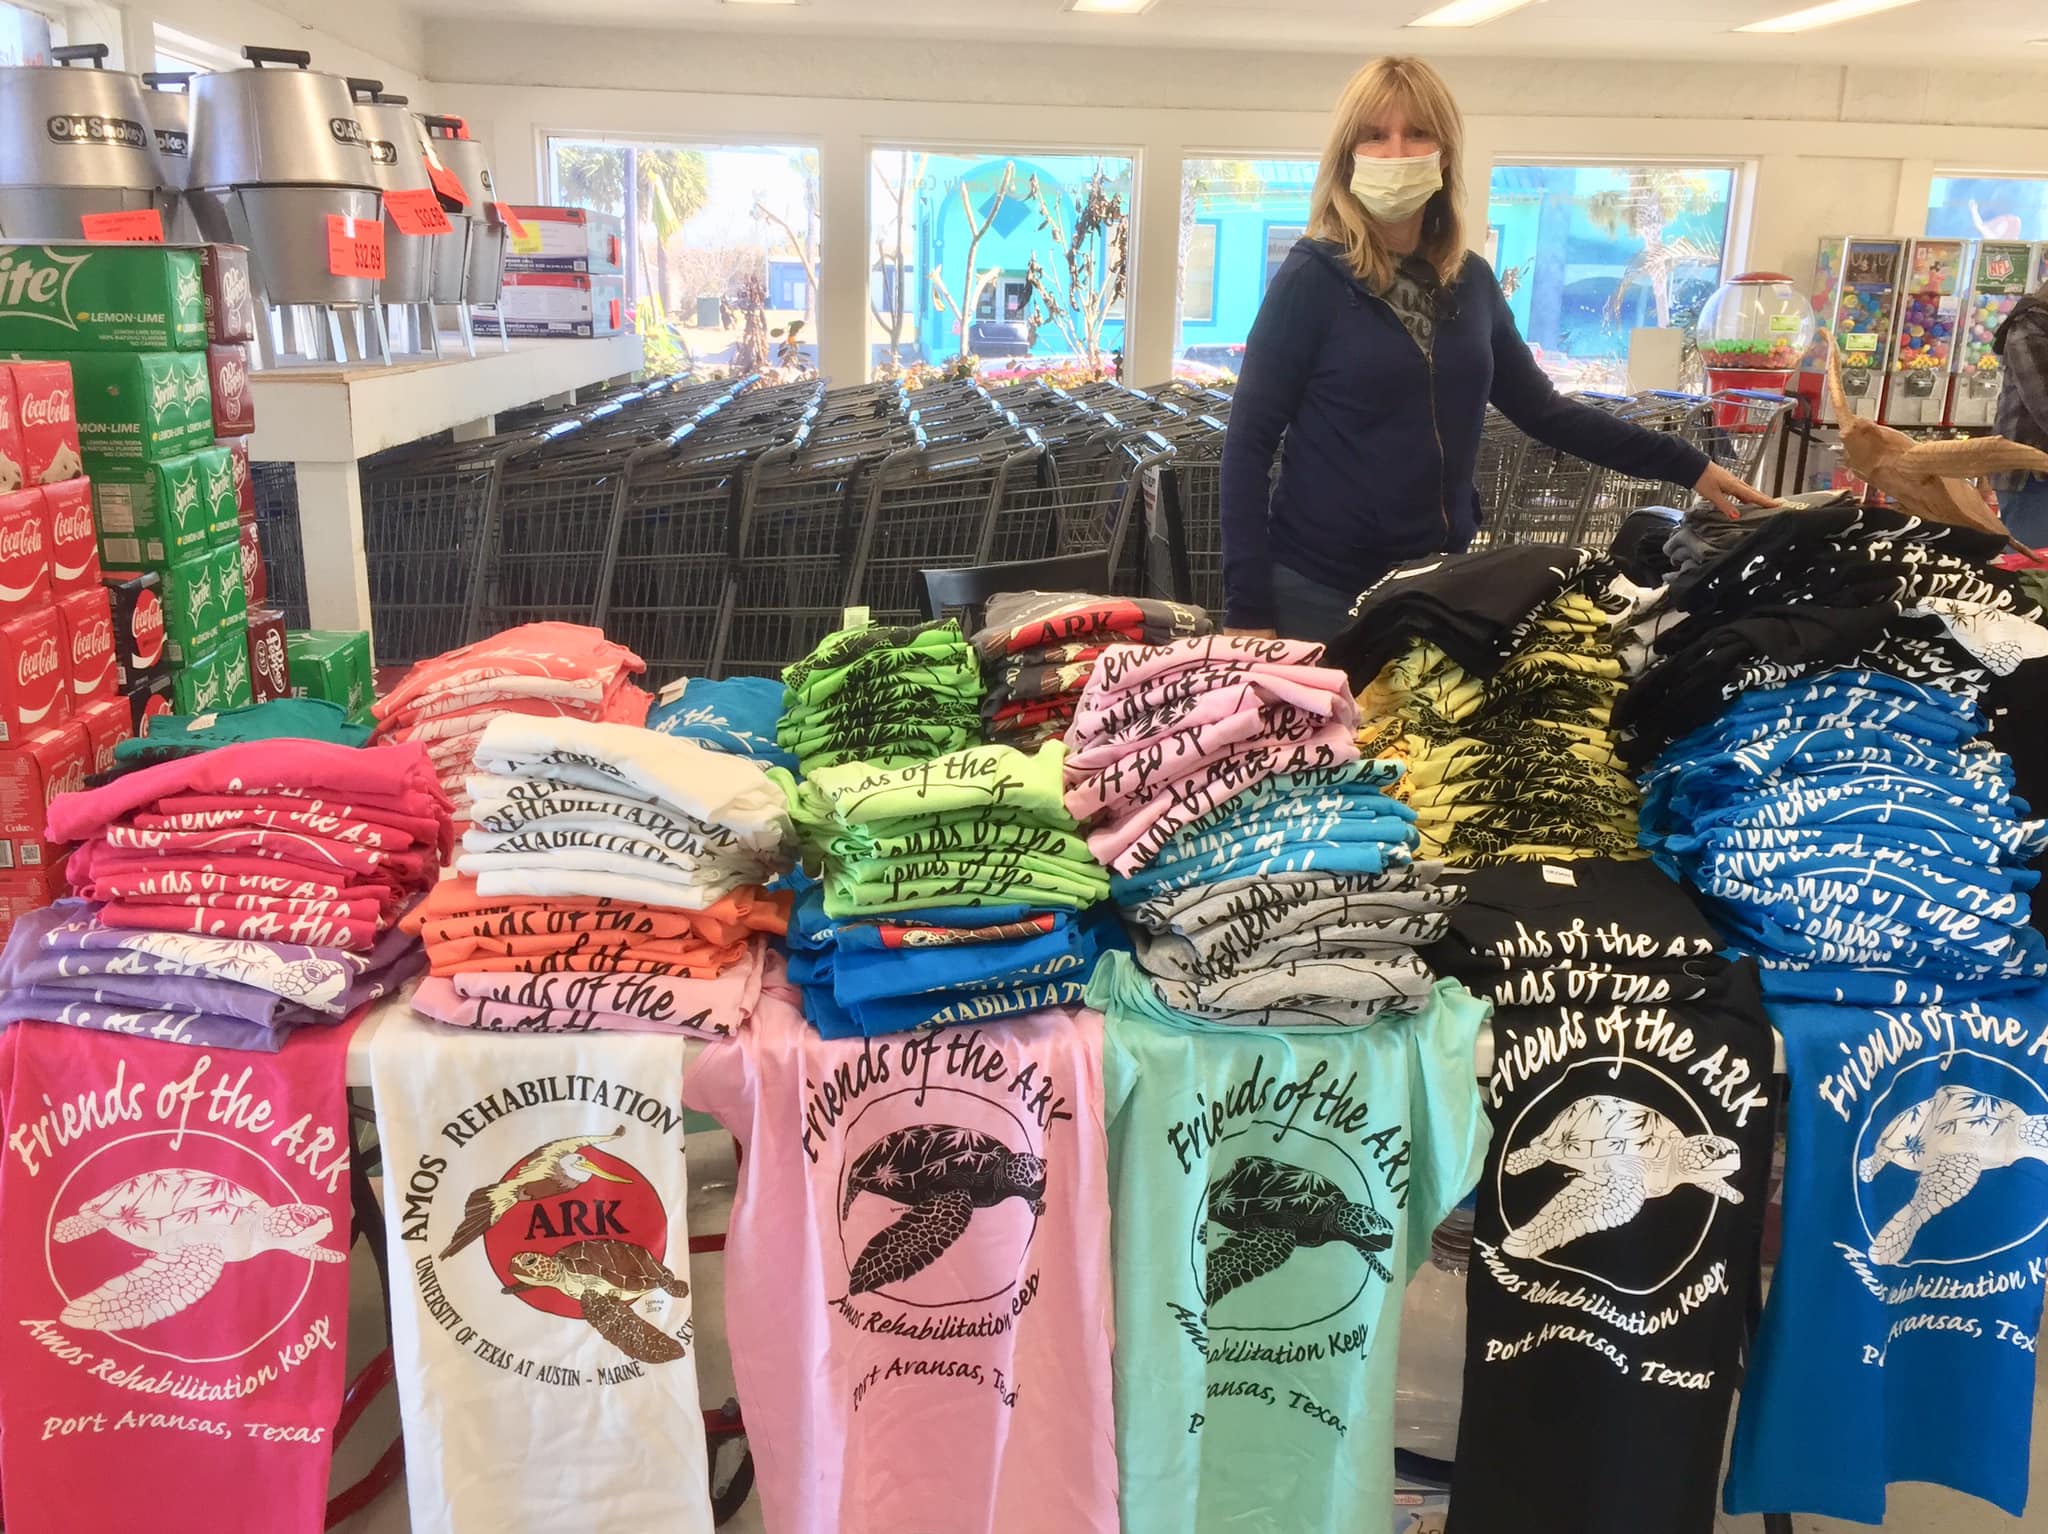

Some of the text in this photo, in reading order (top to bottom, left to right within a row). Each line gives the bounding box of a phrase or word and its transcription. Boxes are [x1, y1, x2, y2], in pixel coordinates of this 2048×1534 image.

[51, 118, 145, 145] Old Smokey
[155, 136, 188, 151] okey
[354, 242, 382, 270] $32.69
[0, 257, 60, 306] ite
[78, 423, 141, 433] MON-LIME
[1039, 609, 1114, 645] ARK
[943, 750, 999, 782] the
[1556, 917, 1591, 960] of
[1595, 921, 1661, 959] the
[611, 973, 678, 1022] the
[901, 1027, 946, 1107] of
[946, 1030, 1008, 1083] the
[1007, 1062, 1074, 1135] ARK
[1595, 1004, 1633, 1081] of
[1634, 1007, 1697, 1064] the
[1687, 1044, 1769, 1129] ARK
[1818, 1009, 1924, 1123] Friends
[1959, 1001, 2029, 1048] the
[9, 1055, 351, 1194] Friends of the ARK
[1167, 1054, 1277, 1175] Friends
[1273, 1060, 1328, 1144] of
[1313, 1072, 1369, 1134] the
[401, 1075, 682, 1242] AMOS REHABILITATION
[524, 1199, 630, 1240] ARK
[828, 1268, 1041, 1341] Amos Rehabilitation eep
[1473, 1236, 1730, 1337] Amos Rehabilitation Keep
[1886, 1269, 2028, 1305] ehabilitation
[415, 1254, 464, 1332] UNIVERSITY
[455, 1325, 477, 1346] OF
[473, 1337, 515, 1370] TEXAS
[514, 1358, 536, 1378] AT
[536, 1365, 581, 1387] AUSTIN
[598, 1360, 646, 1387] MARINE
[1328, 1322, 1369, 1361] Keep
[1995, 1318, 2039, 1354] Tex
[19, 1315, 337, 1402] Amos Rehabilitation Keep
[884, 1356, 985, 1386] Aransas,
[1484, 1322, 1716, 1390] Port Aransas, Texas
[1206, 1380, 1276, 1406] ansas,
[41, 1410, 325, 1444] Port Aransas, Texas
